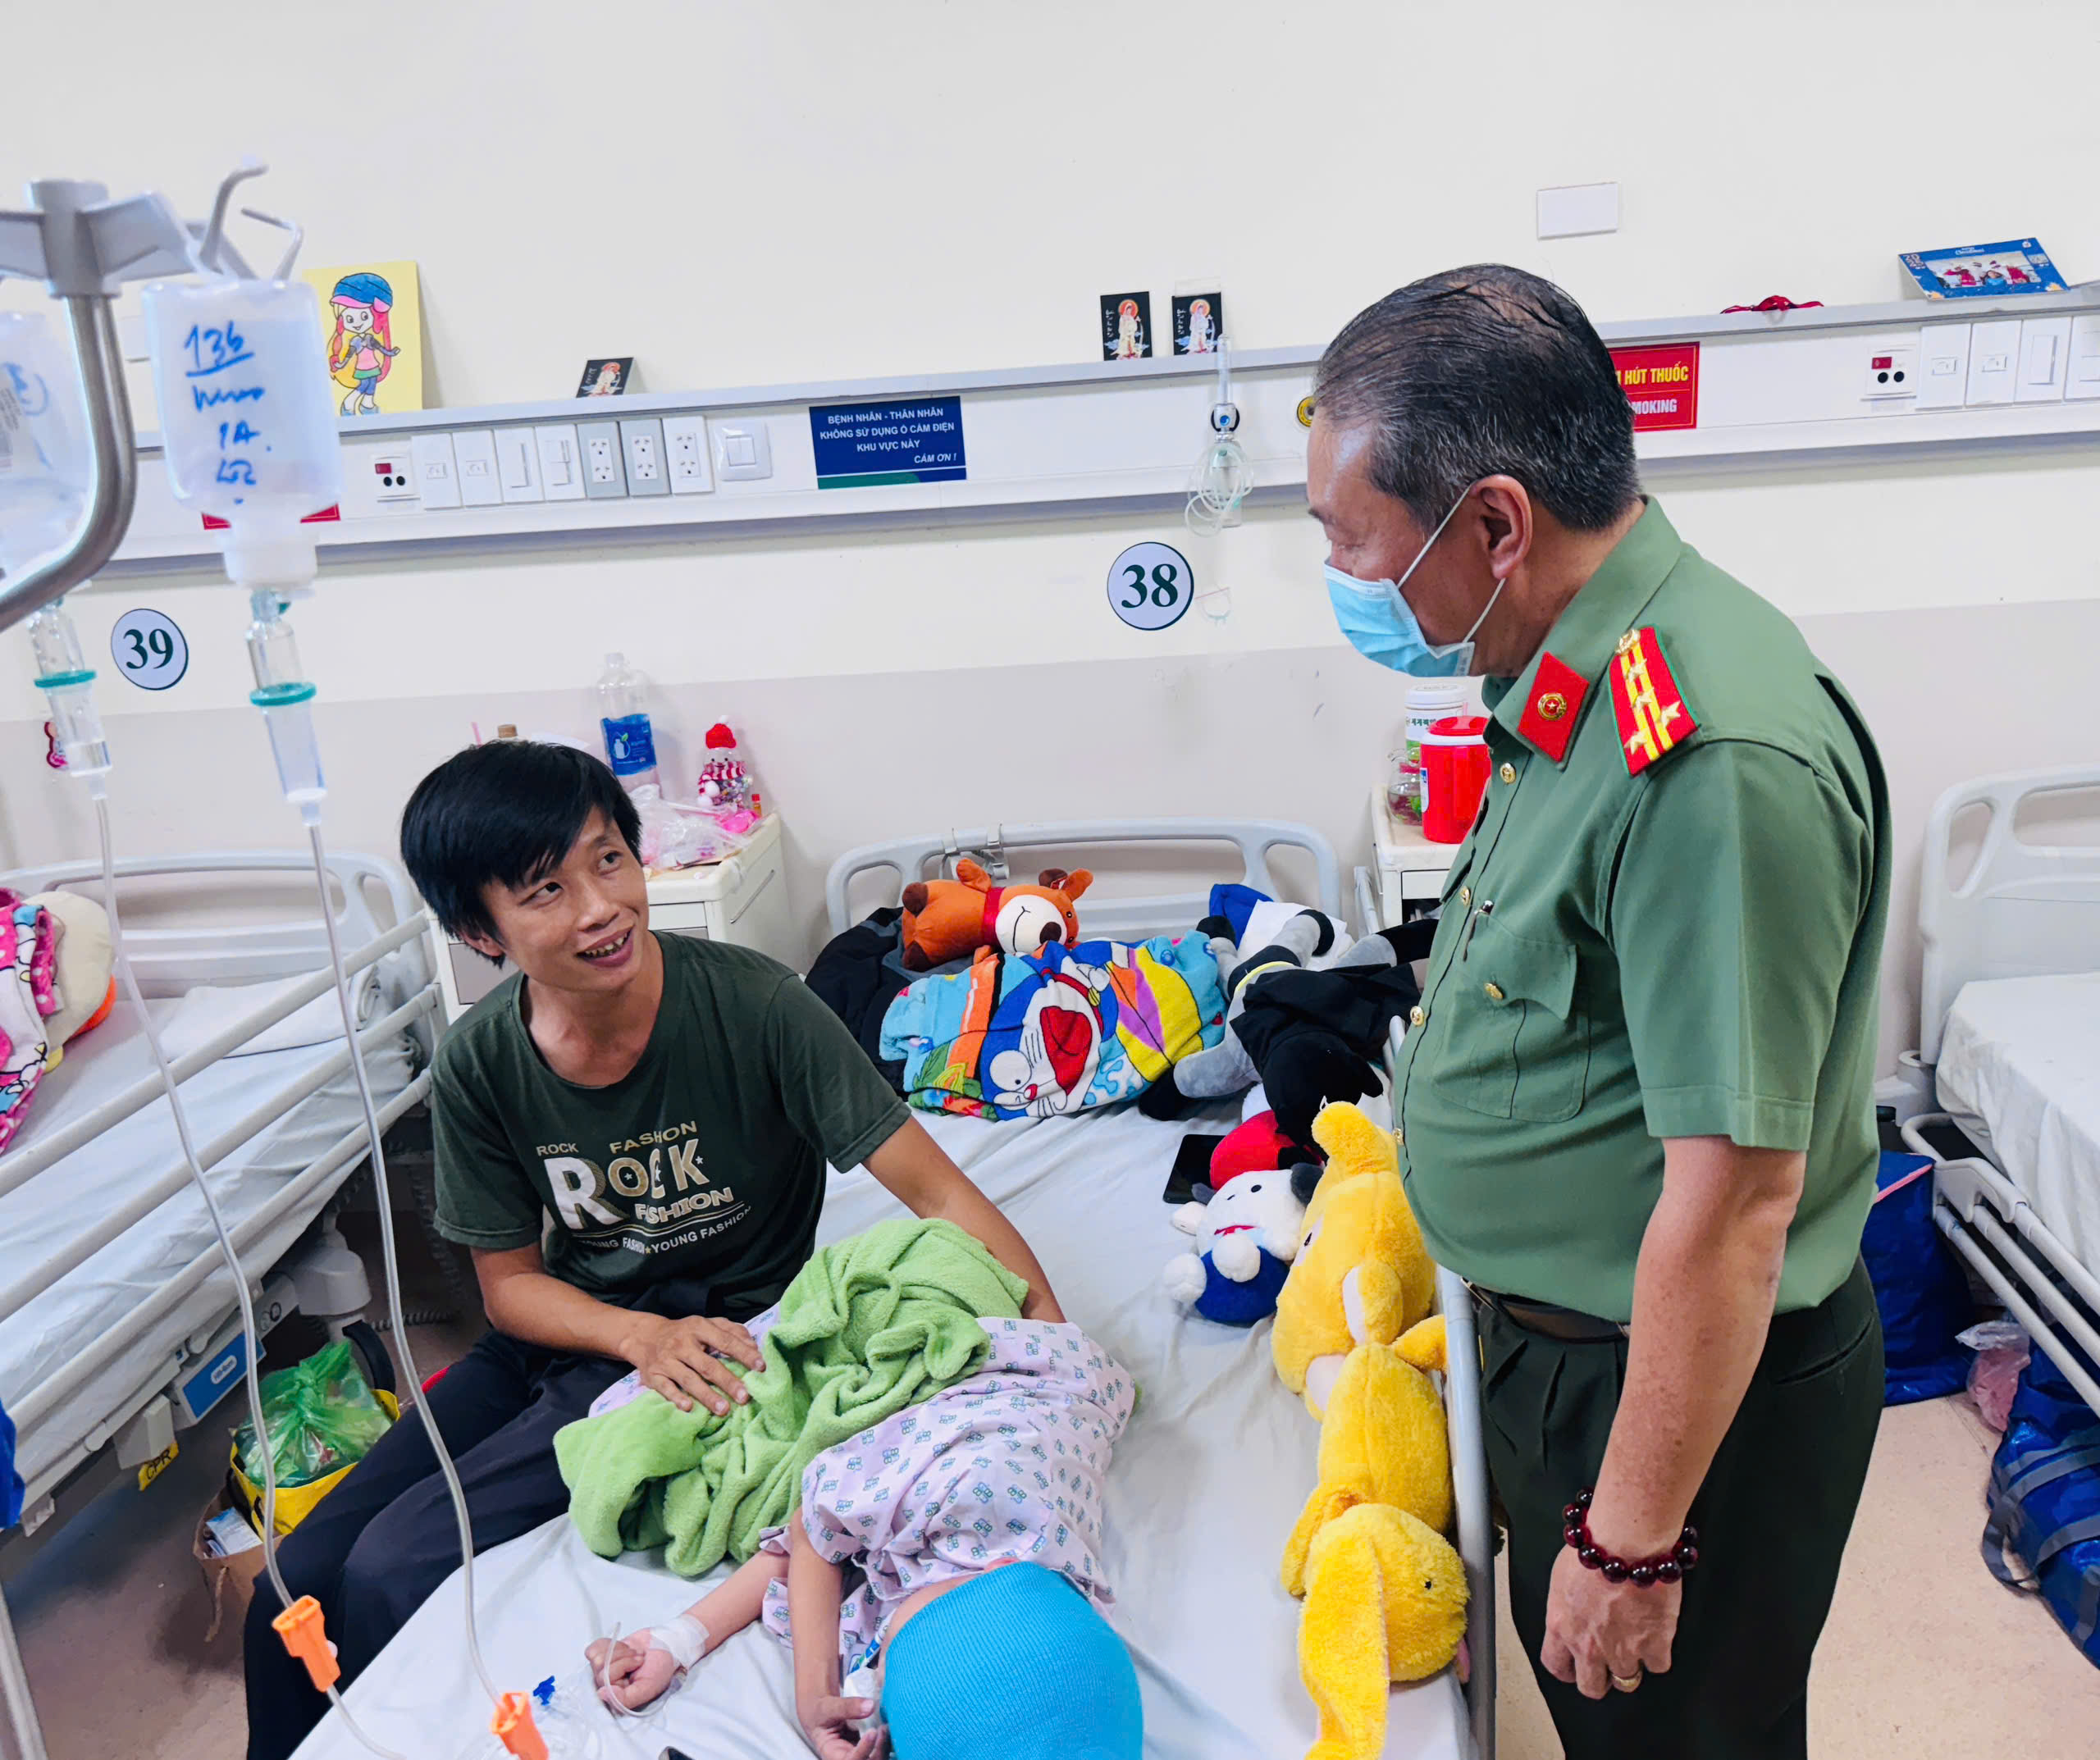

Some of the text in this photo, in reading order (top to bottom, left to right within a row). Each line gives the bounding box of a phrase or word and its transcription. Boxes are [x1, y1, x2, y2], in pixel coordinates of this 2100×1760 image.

[1624, 366, 1648, 385] HÚT
[1650, 361, 1689, 384] THUỐC
[1631, 399, 1678, 415] MOKING
[827, 413, 854, 426] BỆNH
[856, 411, 883, 422] NHÂN
[819, 429, 854, 440] KHÔNG
[871, 426, 899, 437] DỤNG
[932, 421, 955, 433] ĐIỆN
[856, 438, 920, 452] KHU VỰC NÀY
[1121, 563, 1178, 609] 38
[123, 628, 174, 669] 39
[536, 1142, 579, 1156] ROCK
[651, 1231, 698, 1254] YOUNG
[700, 1205, 752, 1239] FASHION
[146, 1448, 171, 1480] CPR
